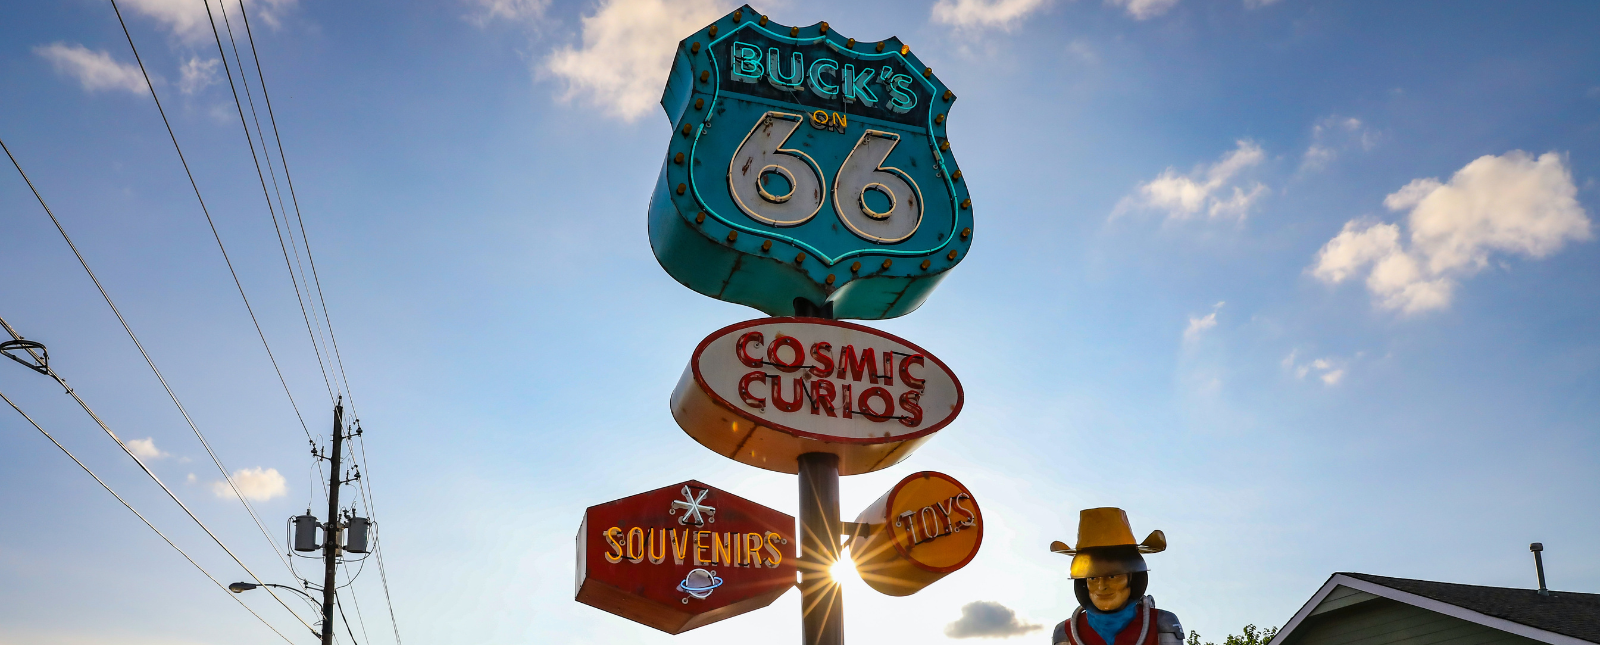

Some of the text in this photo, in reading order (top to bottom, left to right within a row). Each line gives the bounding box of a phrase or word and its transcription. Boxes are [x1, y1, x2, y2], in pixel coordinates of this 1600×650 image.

[731, 41, 917, 113] BUCK'S
[809, 110, 847, 134] ON
[728, 111, 924, 243] 66
[735, 331, 926, 389] COSMIC
[738, 371, 923, 427] CURIOS
[603, 526, 787, 569] SOUVENIRS
[896, 492, 976, 549] TOYS
